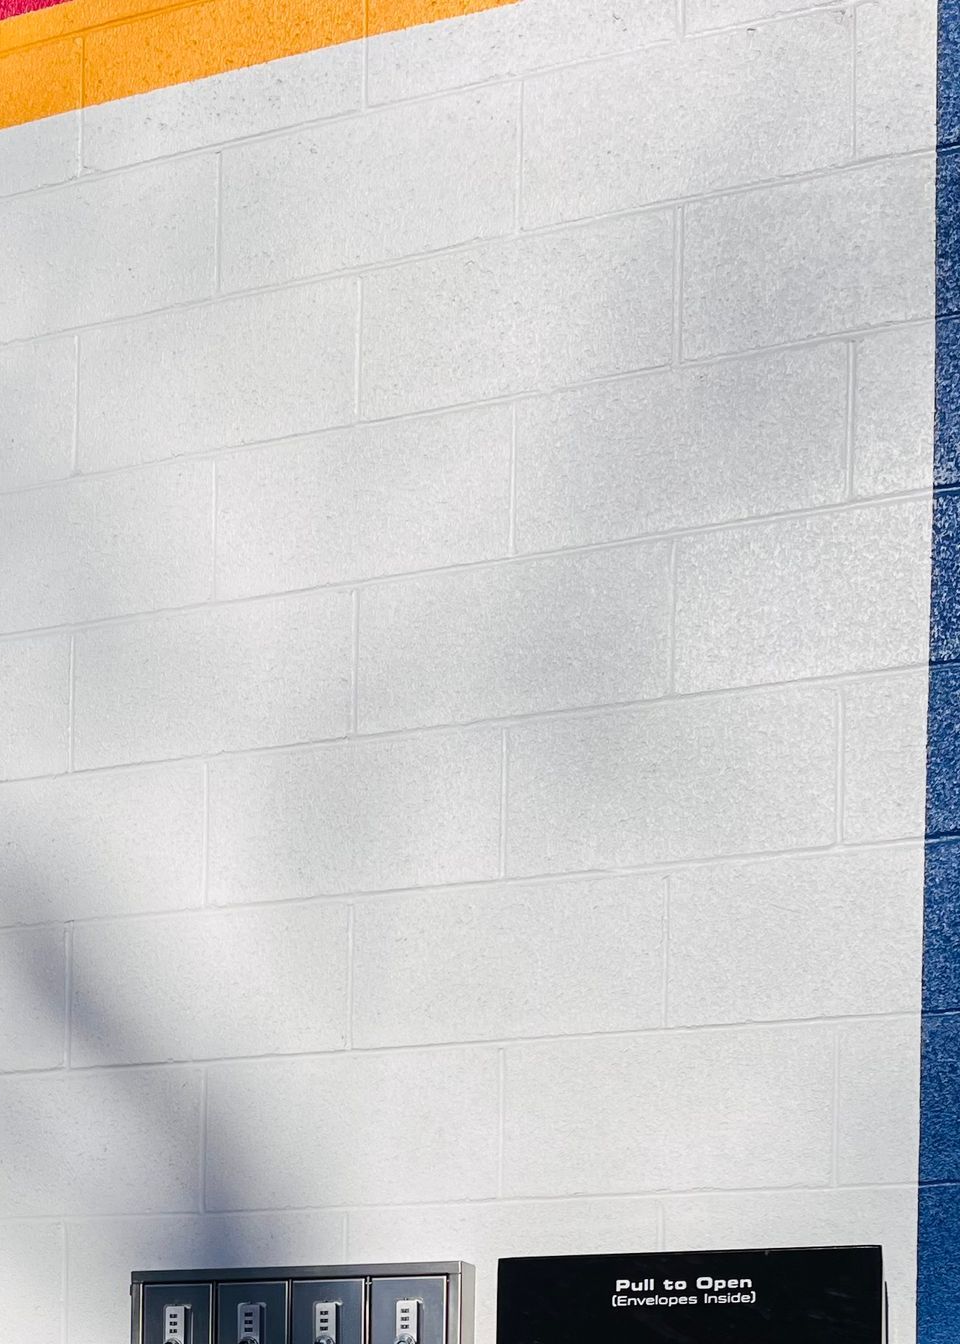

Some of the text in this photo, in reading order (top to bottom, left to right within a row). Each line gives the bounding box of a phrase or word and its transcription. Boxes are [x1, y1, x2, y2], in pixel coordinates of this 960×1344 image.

[615, 1276, 753, 1292] Pull to Open
[611, 1290, 757, 1307] (Envelopes Inside)
